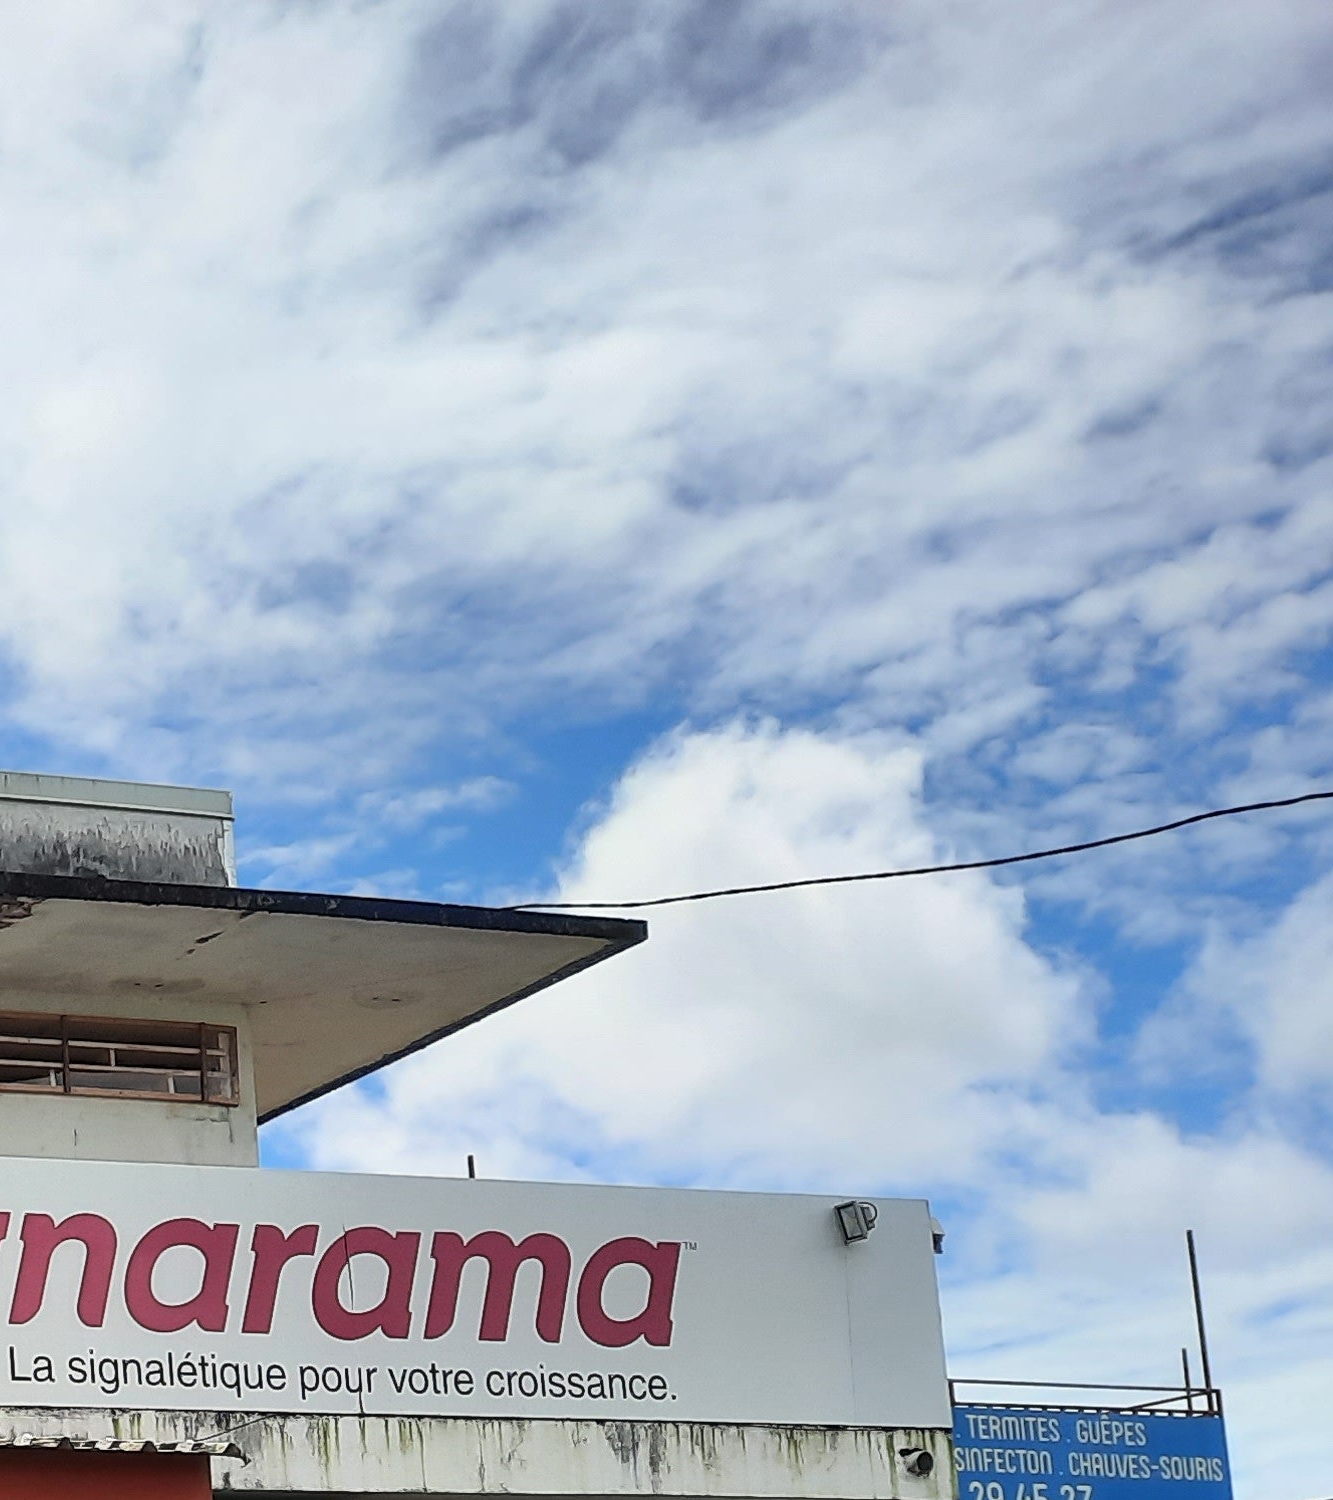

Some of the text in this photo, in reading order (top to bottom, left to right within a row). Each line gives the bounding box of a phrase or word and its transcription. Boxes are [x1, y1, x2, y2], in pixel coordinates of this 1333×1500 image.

[8, 1346, 679, 1402] La signalétique pour votre croissance.
[965, 1414, 1147, 1446] TERMITES GUÊPES
[1069, 1452, 1225, 1482] CHAUVES-SOURIS
